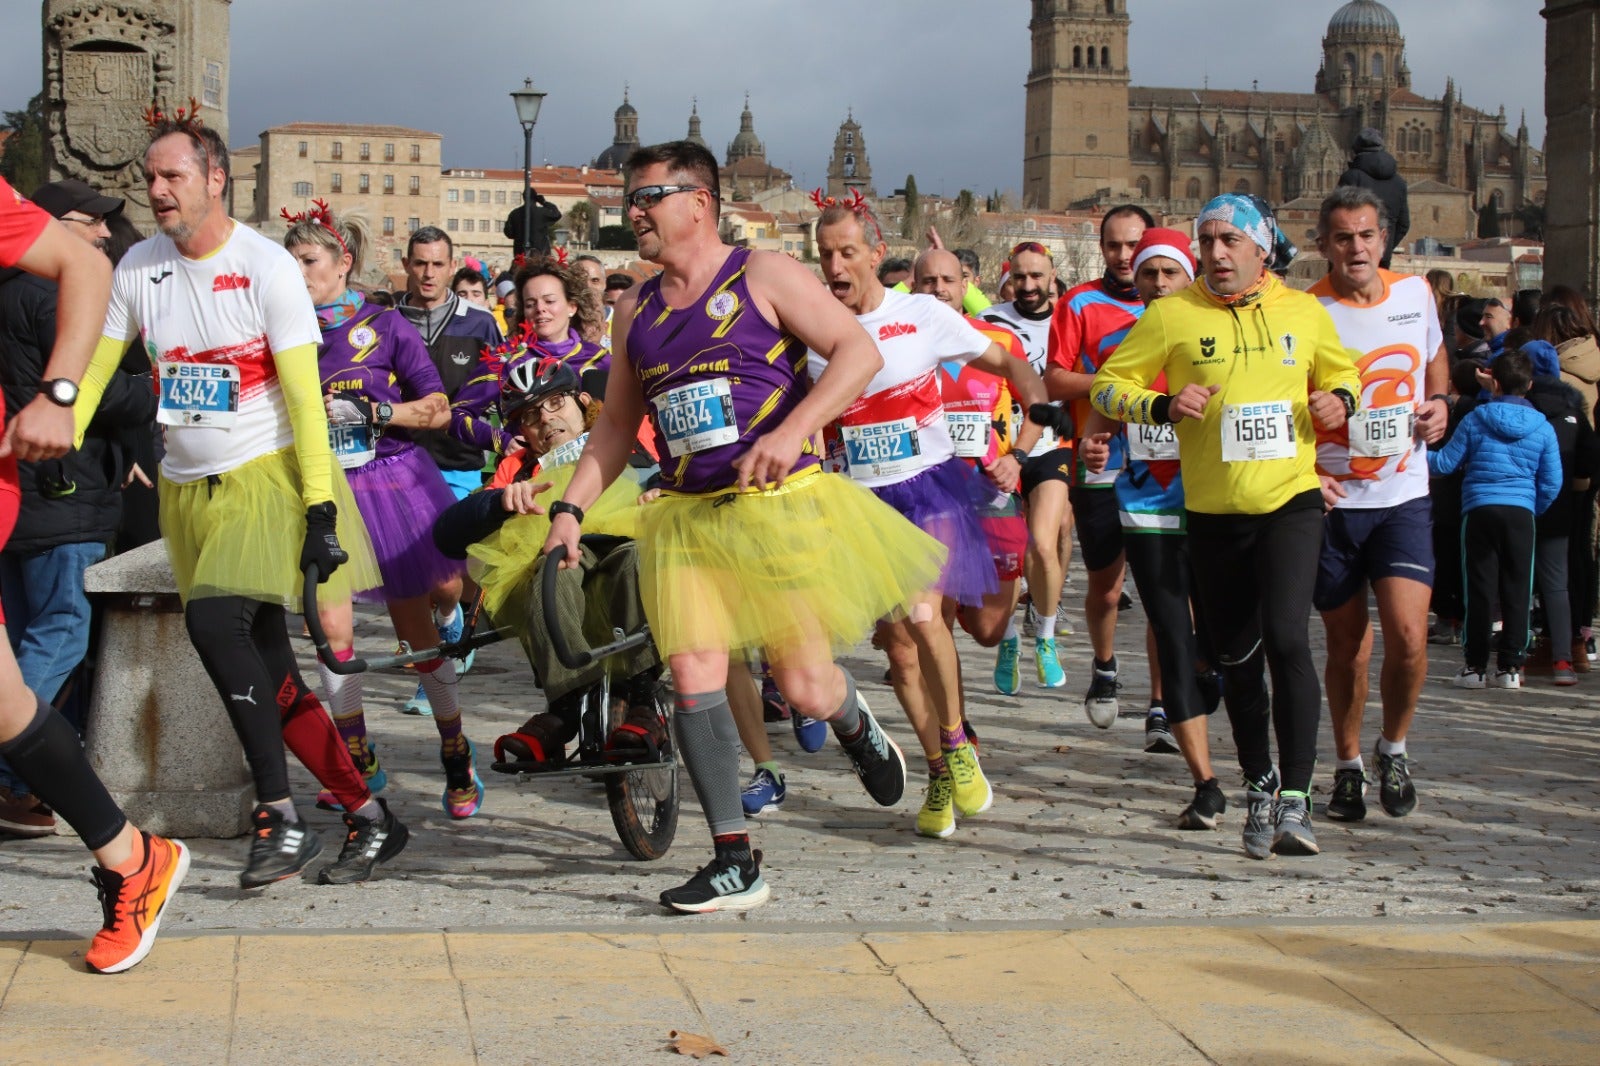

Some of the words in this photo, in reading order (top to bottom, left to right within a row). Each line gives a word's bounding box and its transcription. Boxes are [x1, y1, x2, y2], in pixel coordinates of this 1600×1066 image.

[1192, 358, 1226, 366] BRAGANÇA
[180, 366, 231, 378] SETE
[640, 361, 669, 380] Jamón
[169, 379, 218, 406] 4342
[330, 379, 363, 390] PRIM
[665, 400, 712, 435] 2684
[948, 414, 986, 422] SETEL
[1242, 404, 1286, 416] SETEL
[1369, 406, 1409, 419] SETEL
[862, 422, 910, 436] SETEL
[1139, 423, 1174, 443] 1423
[1235, 417, 1277, 441] 1565
[1366, 419, 1396, 440] 1615
[855, 435, 903, 460] 2682
